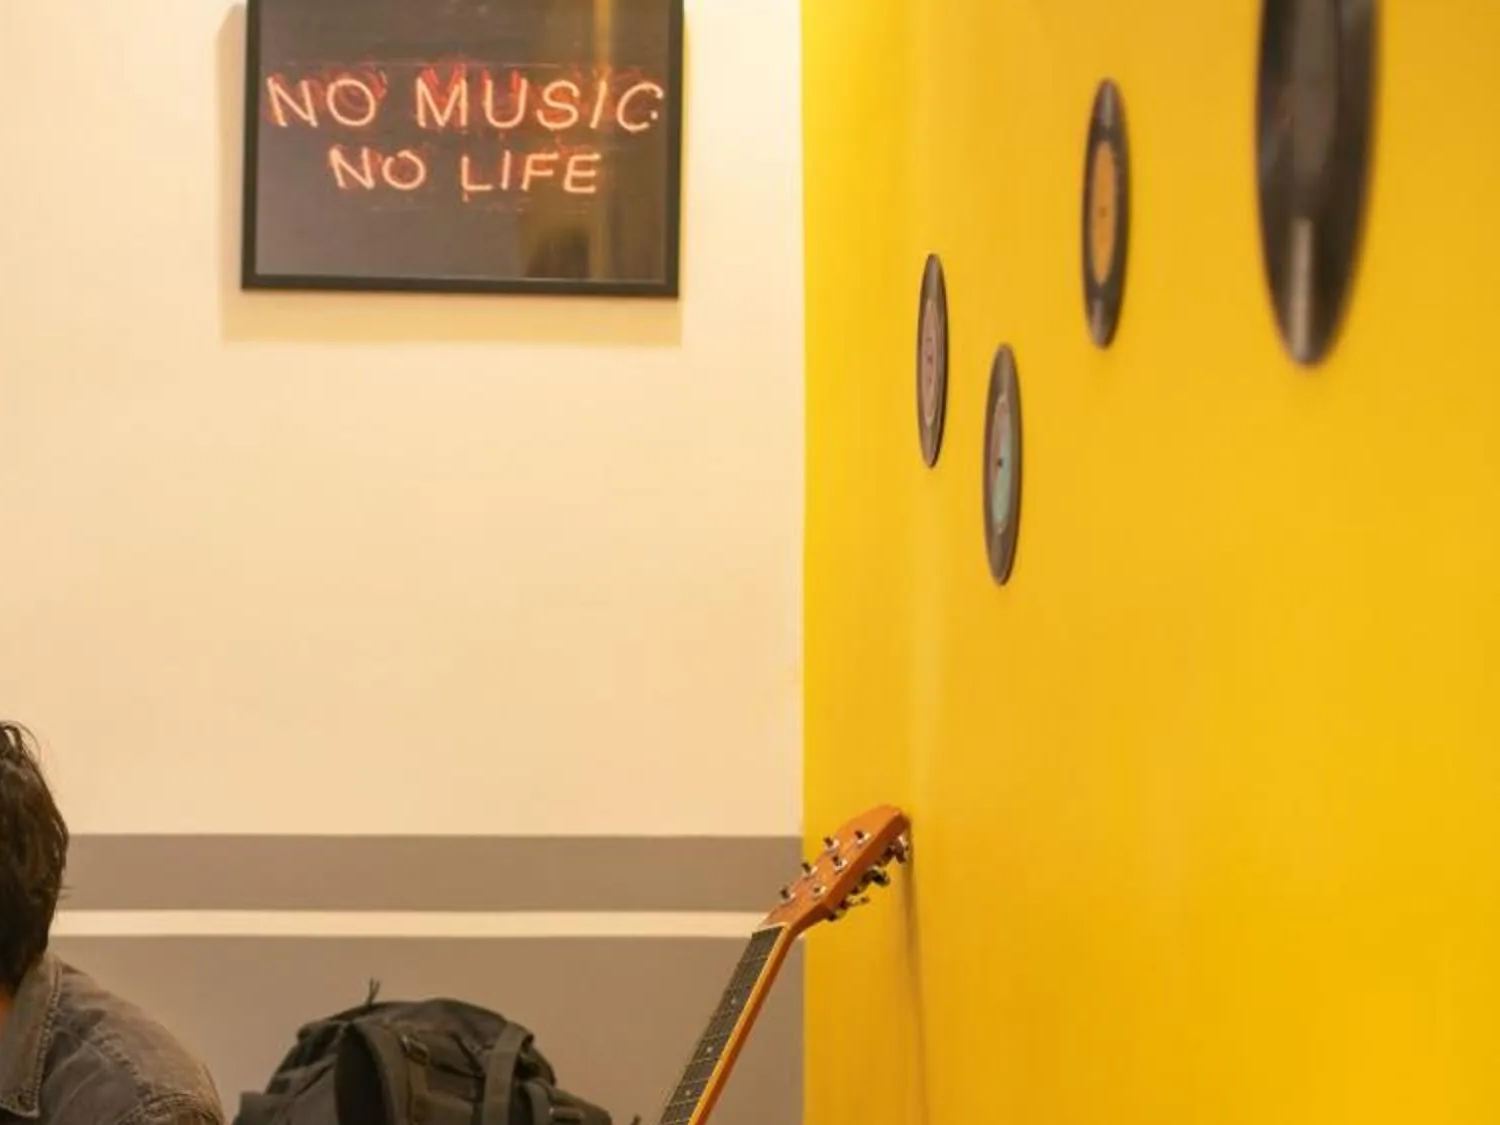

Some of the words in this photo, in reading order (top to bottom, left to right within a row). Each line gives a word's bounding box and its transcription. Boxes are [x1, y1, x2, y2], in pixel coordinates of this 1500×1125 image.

[266, 76, 377, 128] NO
[414, 76, 665, 132] MUSIC
[328, 146, 427, 191] NO
[459, 149, 602, 195] LIFE
